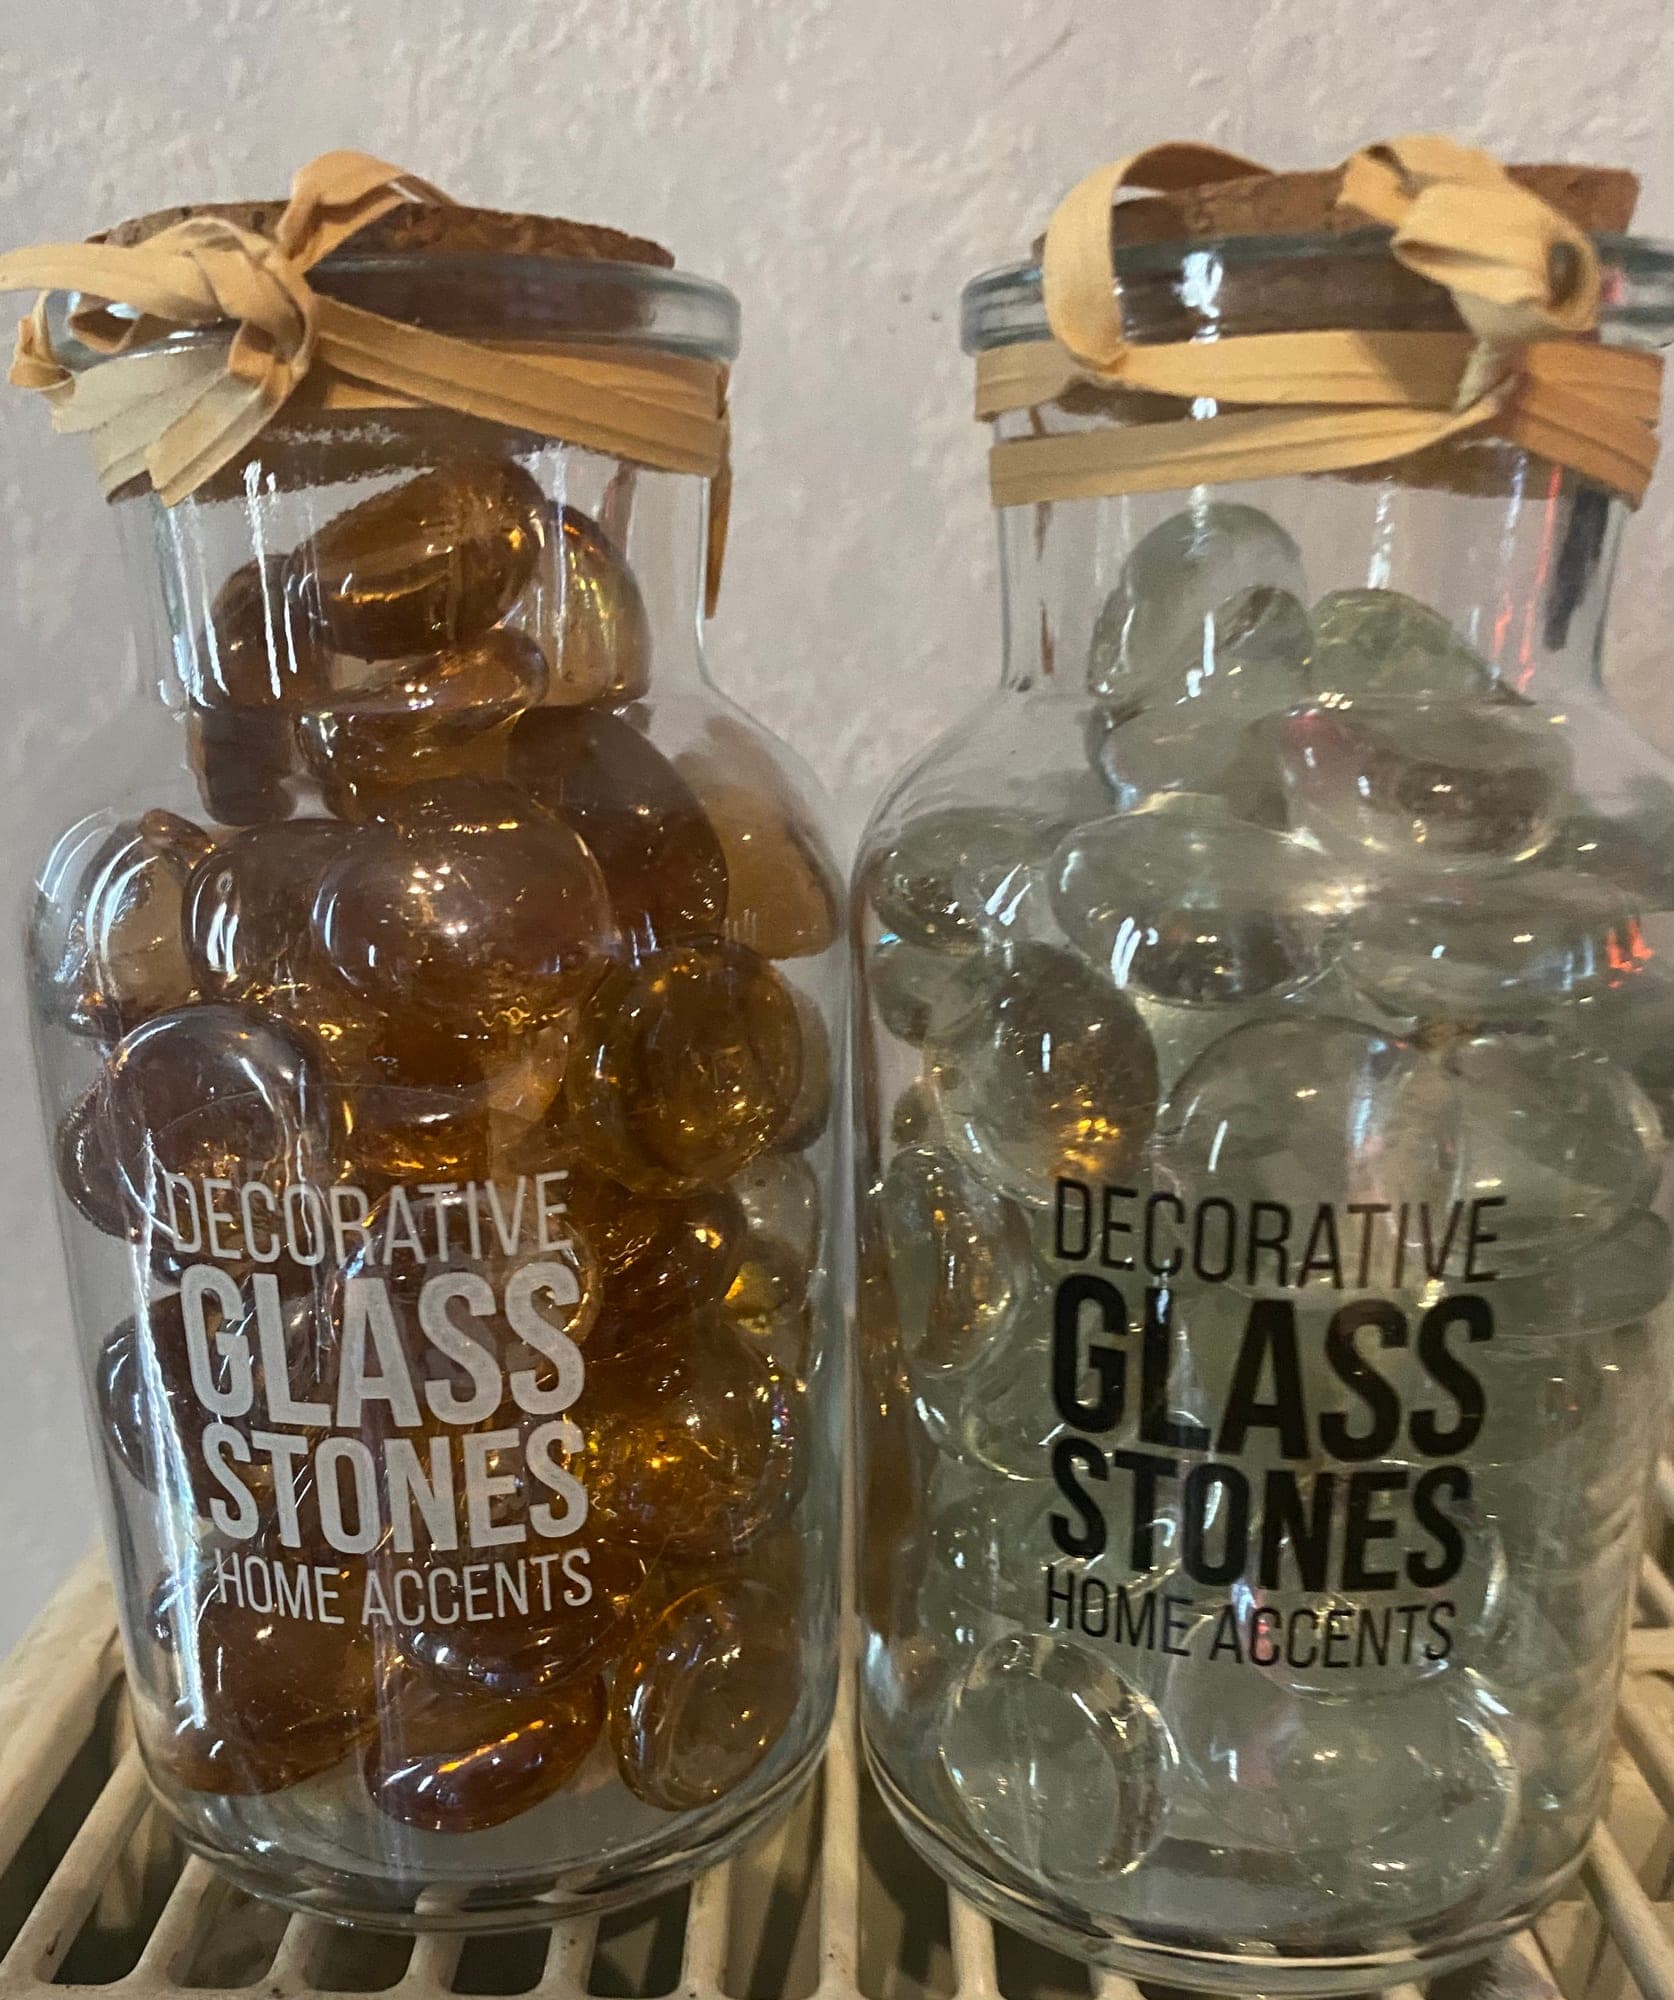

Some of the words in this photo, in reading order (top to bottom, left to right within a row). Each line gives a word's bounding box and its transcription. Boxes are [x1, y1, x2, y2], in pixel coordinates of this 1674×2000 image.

[163, 1170, 573, 1266] DECORATIVE
[1054, 1177, 1508, 1289] DECORATIVE
[180, 1262, 585, 1428] GLASS
[1051, 1274, 1494, 1462] GLASS
[201, 1420, 589, 1554] STONES
[1048, 1437, 1473, 1592] STONES
[215, 1548, 345, 1624] HOME
[361, 1548, 593, 1626] ACCENTS
[1044, 1563, 1192, 1657] HOME
[1209, 1601, 1456, 1668] ACCENTS
